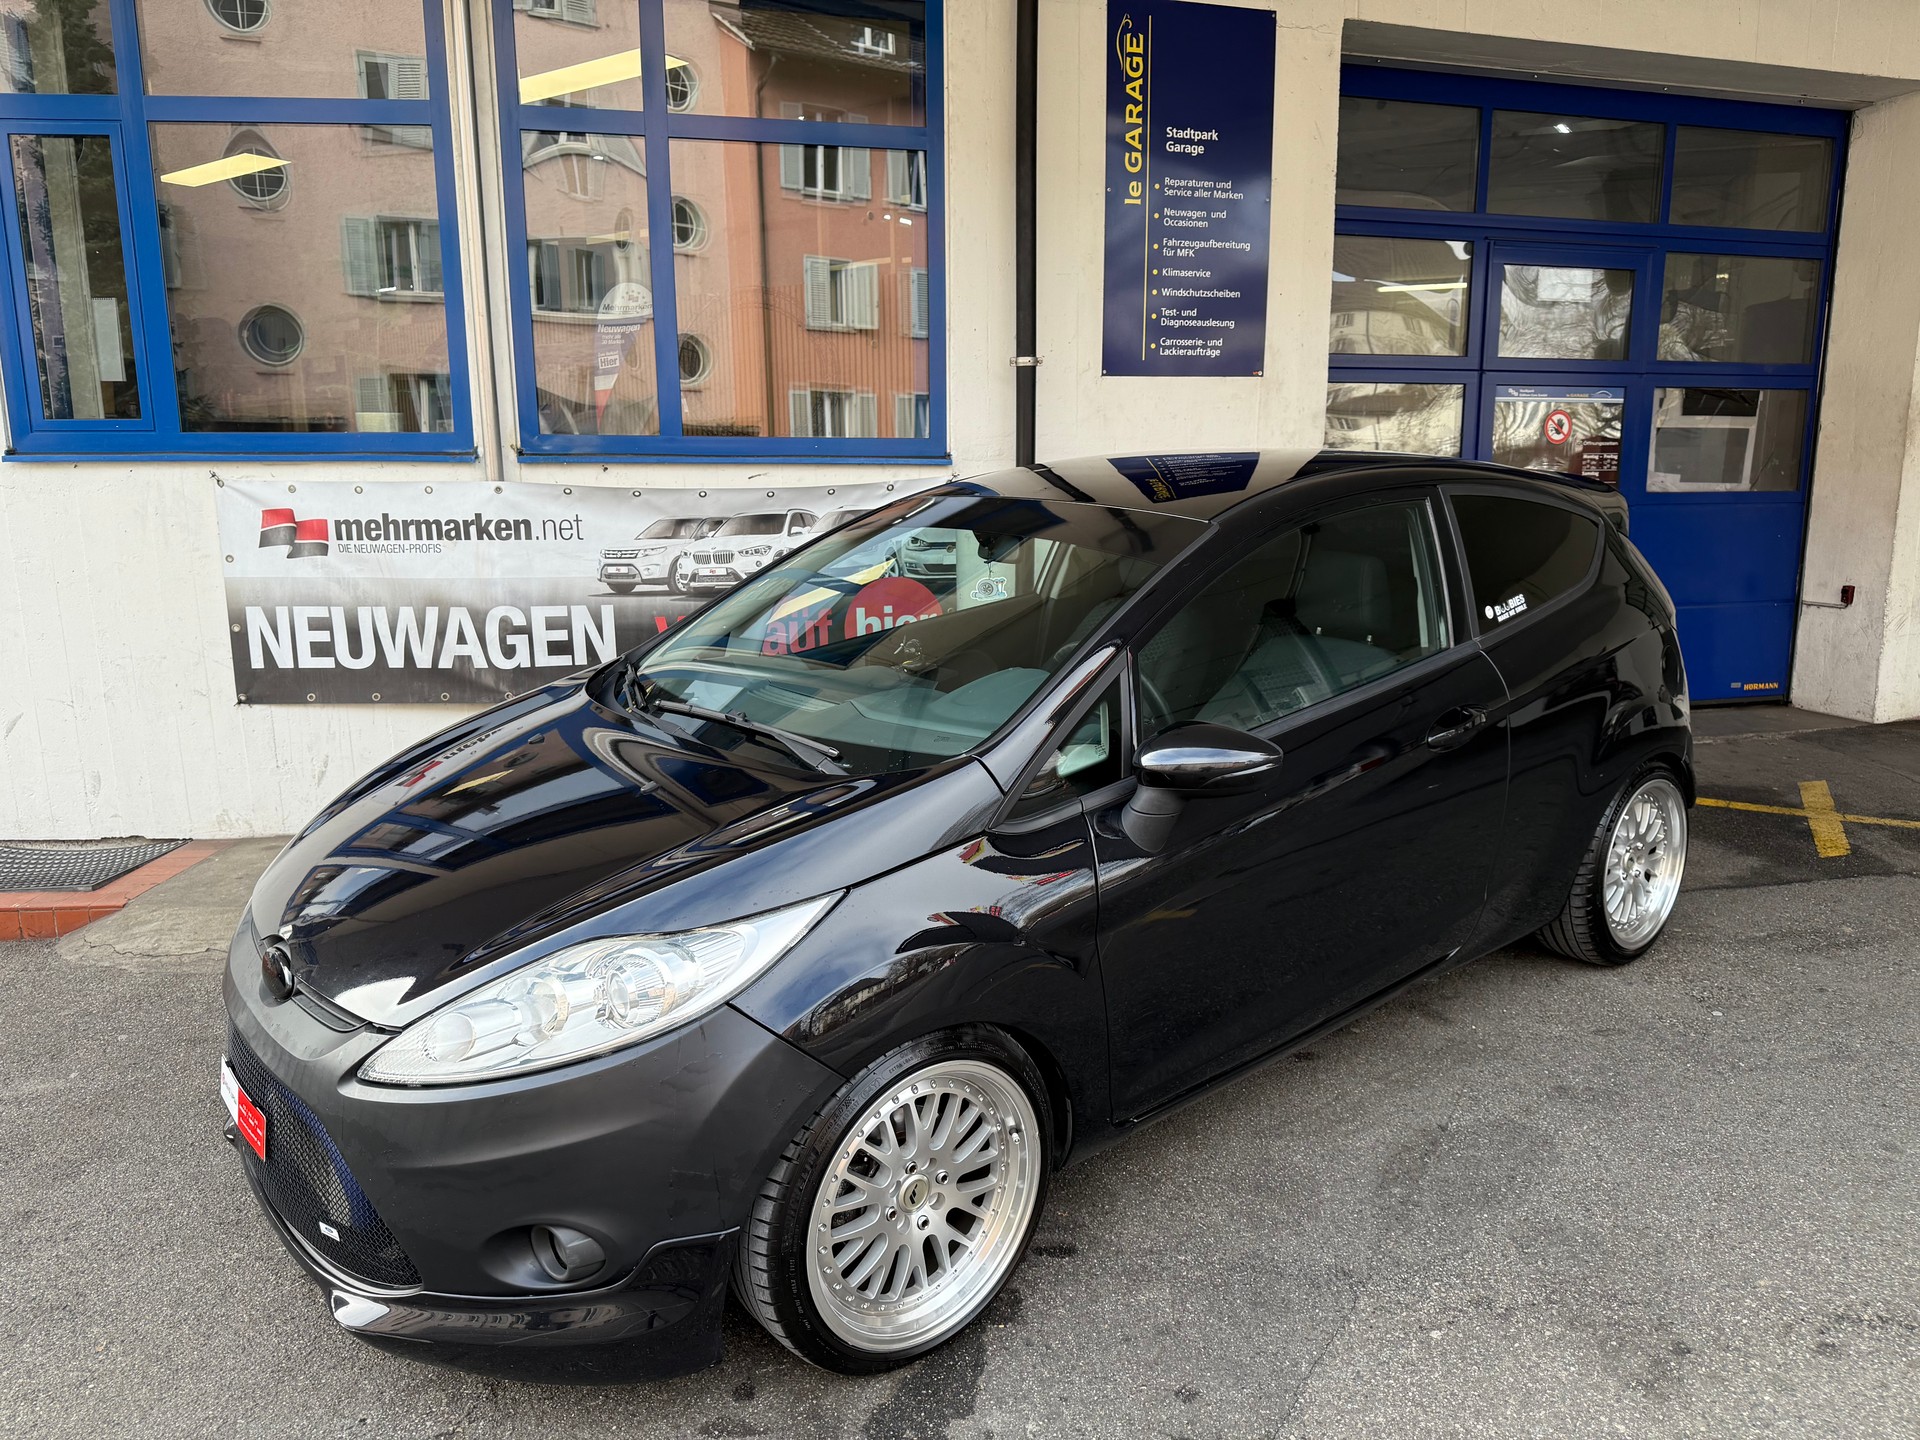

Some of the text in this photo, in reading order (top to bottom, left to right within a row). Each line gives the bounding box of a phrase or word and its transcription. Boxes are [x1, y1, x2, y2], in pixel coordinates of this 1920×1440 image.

[1124, 33, 1144, 205] le GARAGE
[1166, 126, 1219, 142] Stadtpark
[1165, 141, 1205, 156] Garage
[1164, 177, 1232, 189] Reparaturen und
[1164, 187, 1244, 200] Service aller Marken
[1163, 208, 1227, 219] Neuwagen und
[1163, 218, 1208, 228] Occasionen
[1163, 238, 1251, 251] Fahrzeugaufbereitung
[1163, 247, 1195, 257] für MFK
[1162, 268, 1212, 278] Klimaservice
[1161, 288, 1241, 298] Windschutzscheiben
[1160, 308, 1197, 317] Test- und
[1160, 317, 1235, 329] Diagnoseauslesung
[597, 324, 640, 334] Neuwagen
[1160, 337, 1223, 346] Carrosserie- und
[1160, 347, 1221, 358] Lackieraufträge
[600, 358, 618, 368] Hier
[334, 513, 584, 541] mehrmarken.net
[338, 543, 442, 554] DIE NEUWAGEN-PROFIS
[245, 604, 617, 670] NEUWAGEN
